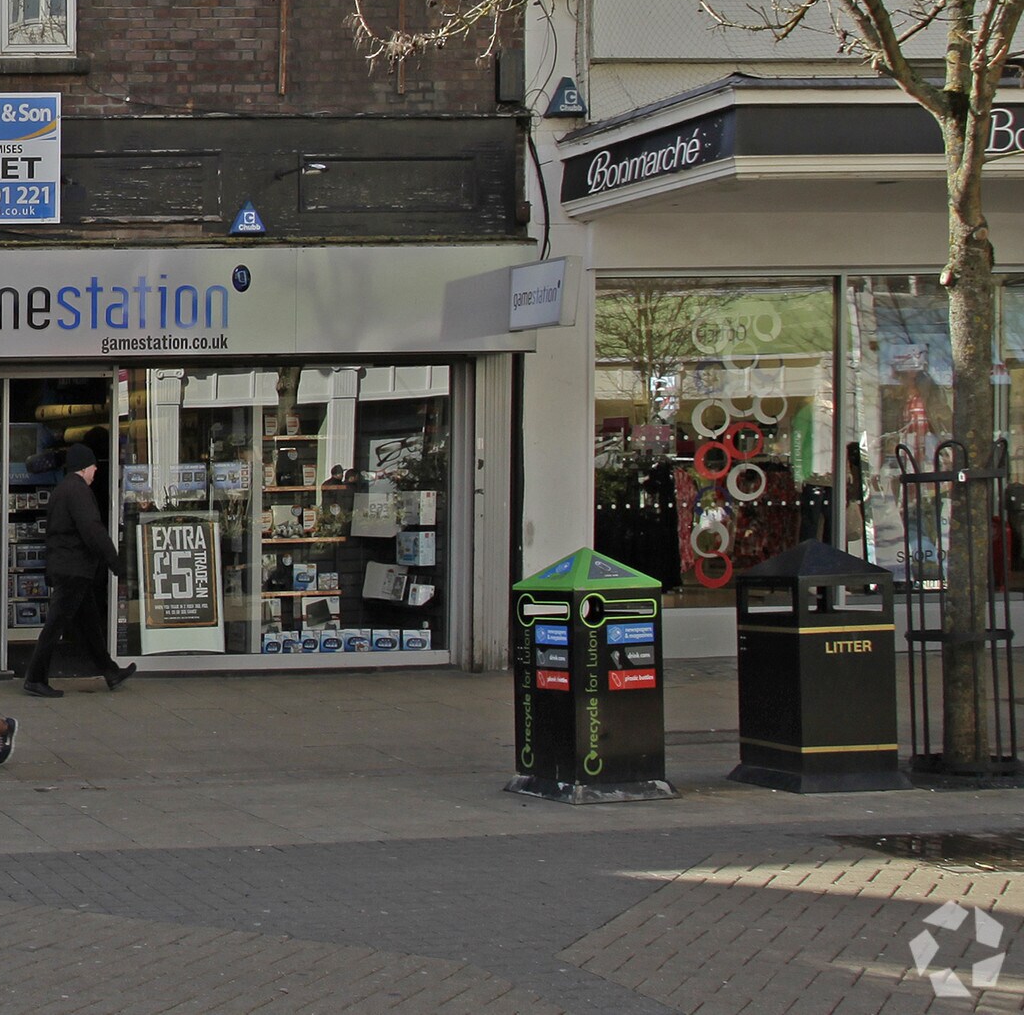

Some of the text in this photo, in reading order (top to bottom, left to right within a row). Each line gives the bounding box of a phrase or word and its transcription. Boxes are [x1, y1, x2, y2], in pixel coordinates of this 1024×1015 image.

[1, 103, 17, 123] &
[18, 103, 52, 122] Son
[587, 127, 700, 194] Bonmarché
[16, 185, 50, 204] 221
[101, 334, 229, 354] gamestation.co.uk
[151, 525, 207, 551] EXTRA
[152, 551, 194, 600] £5
[194, 550, 209, 598] TRADE-IN
[825, 640, 872, 654] LITTER
[585, 630, 601, 749] recycle for Luton
[523, 694, 533, 743] recycle
